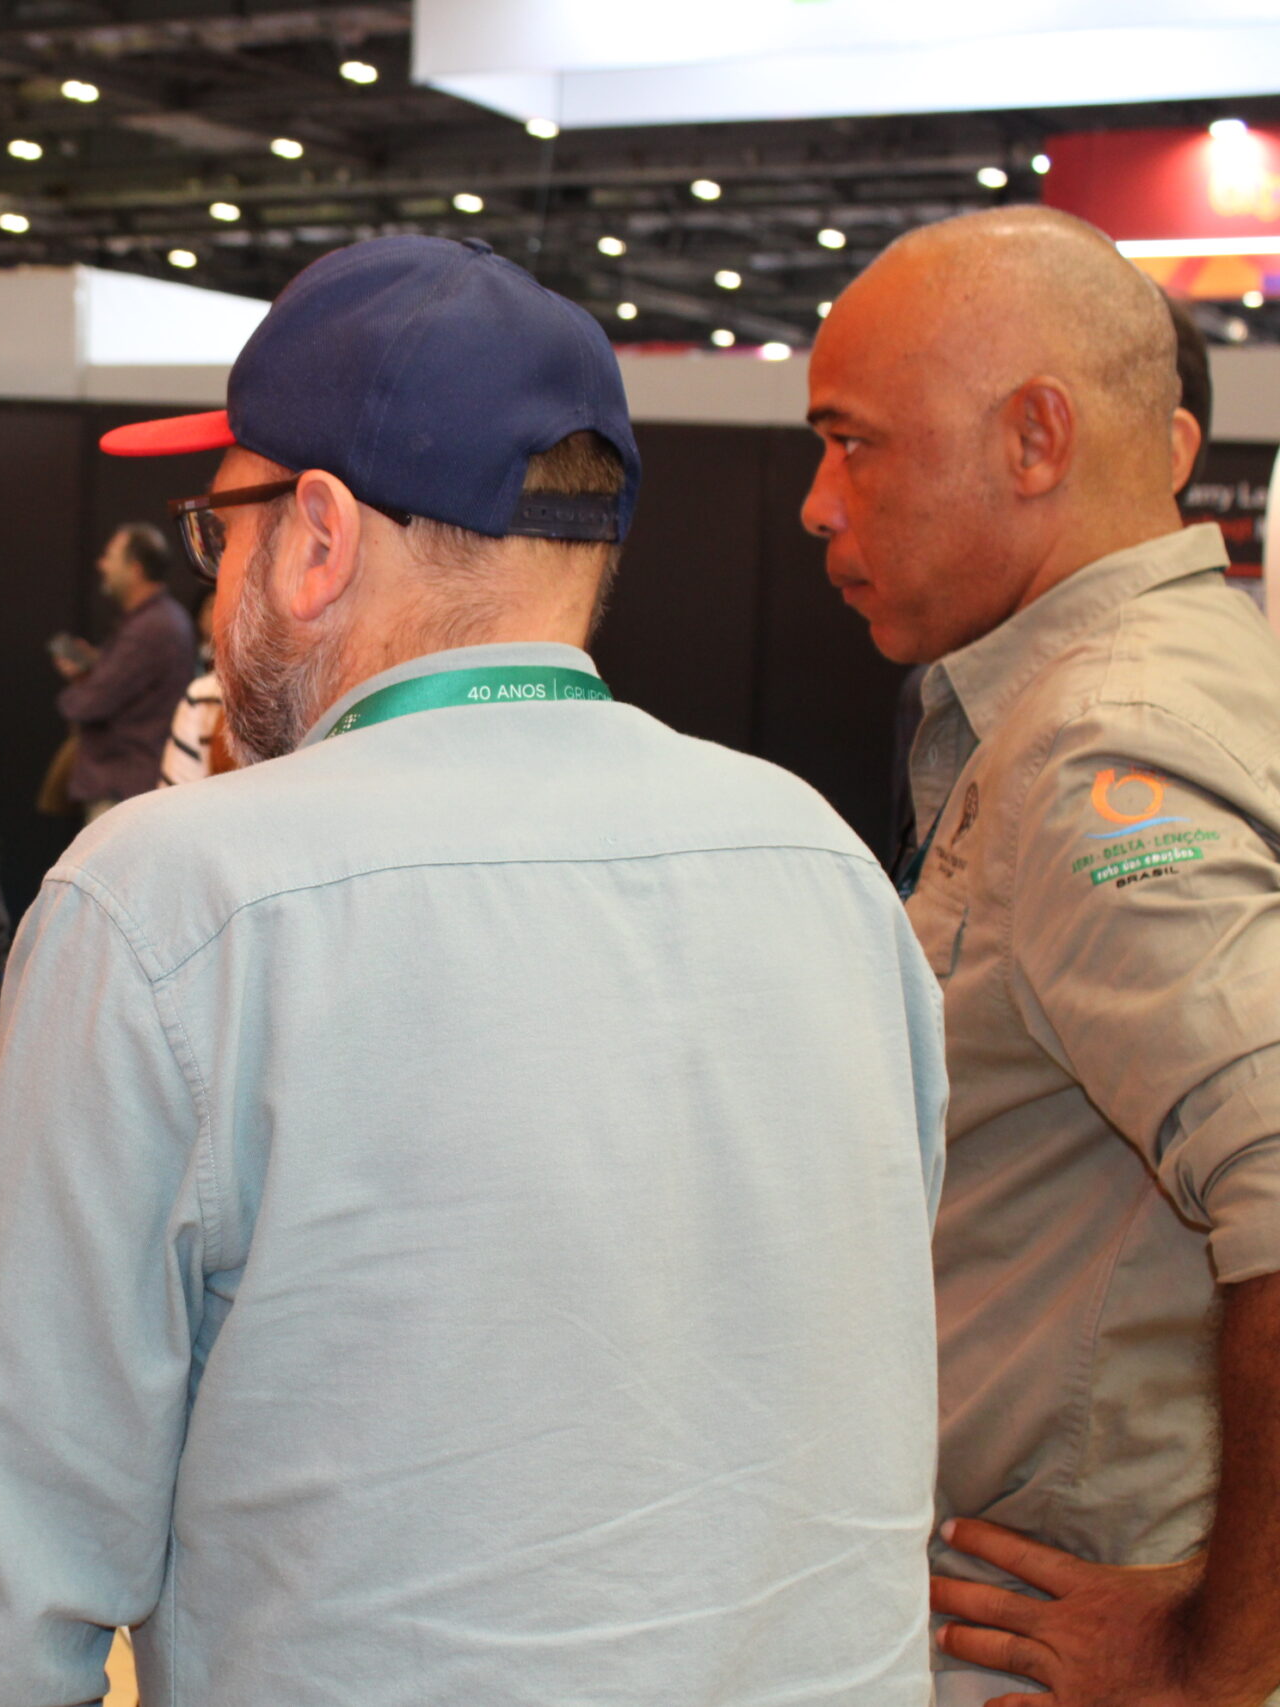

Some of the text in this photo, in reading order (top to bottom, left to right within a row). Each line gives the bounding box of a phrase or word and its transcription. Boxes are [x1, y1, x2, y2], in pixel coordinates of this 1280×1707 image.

[467, 685, 491, 700] 40
[497, 684, 546, 699] ANOS
[1104, 839, 1145, 859] DELTA
[1116, 866, 1179, 888] BRASIL
